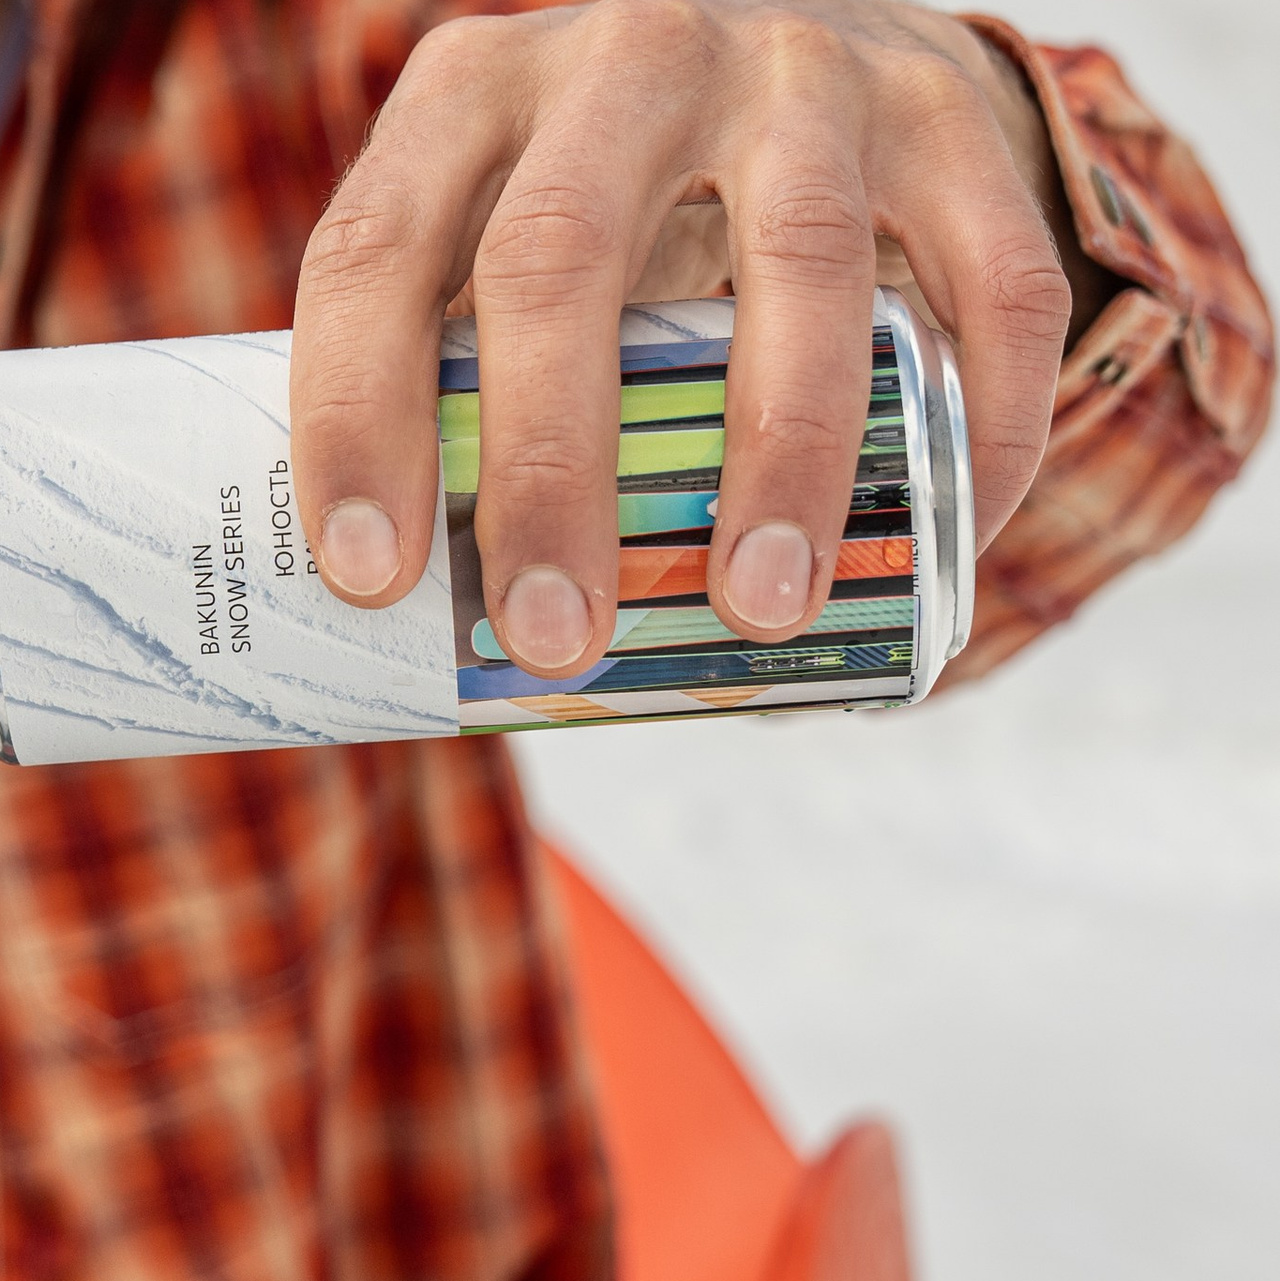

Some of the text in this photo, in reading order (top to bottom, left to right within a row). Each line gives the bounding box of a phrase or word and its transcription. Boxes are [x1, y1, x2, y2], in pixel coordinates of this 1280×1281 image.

[220, 484, 252, 654] SNOW SERIES
[269, 459, 296, 578] ЮНОСТЬ
[192, 544, 220, 655] BAKUNIN
